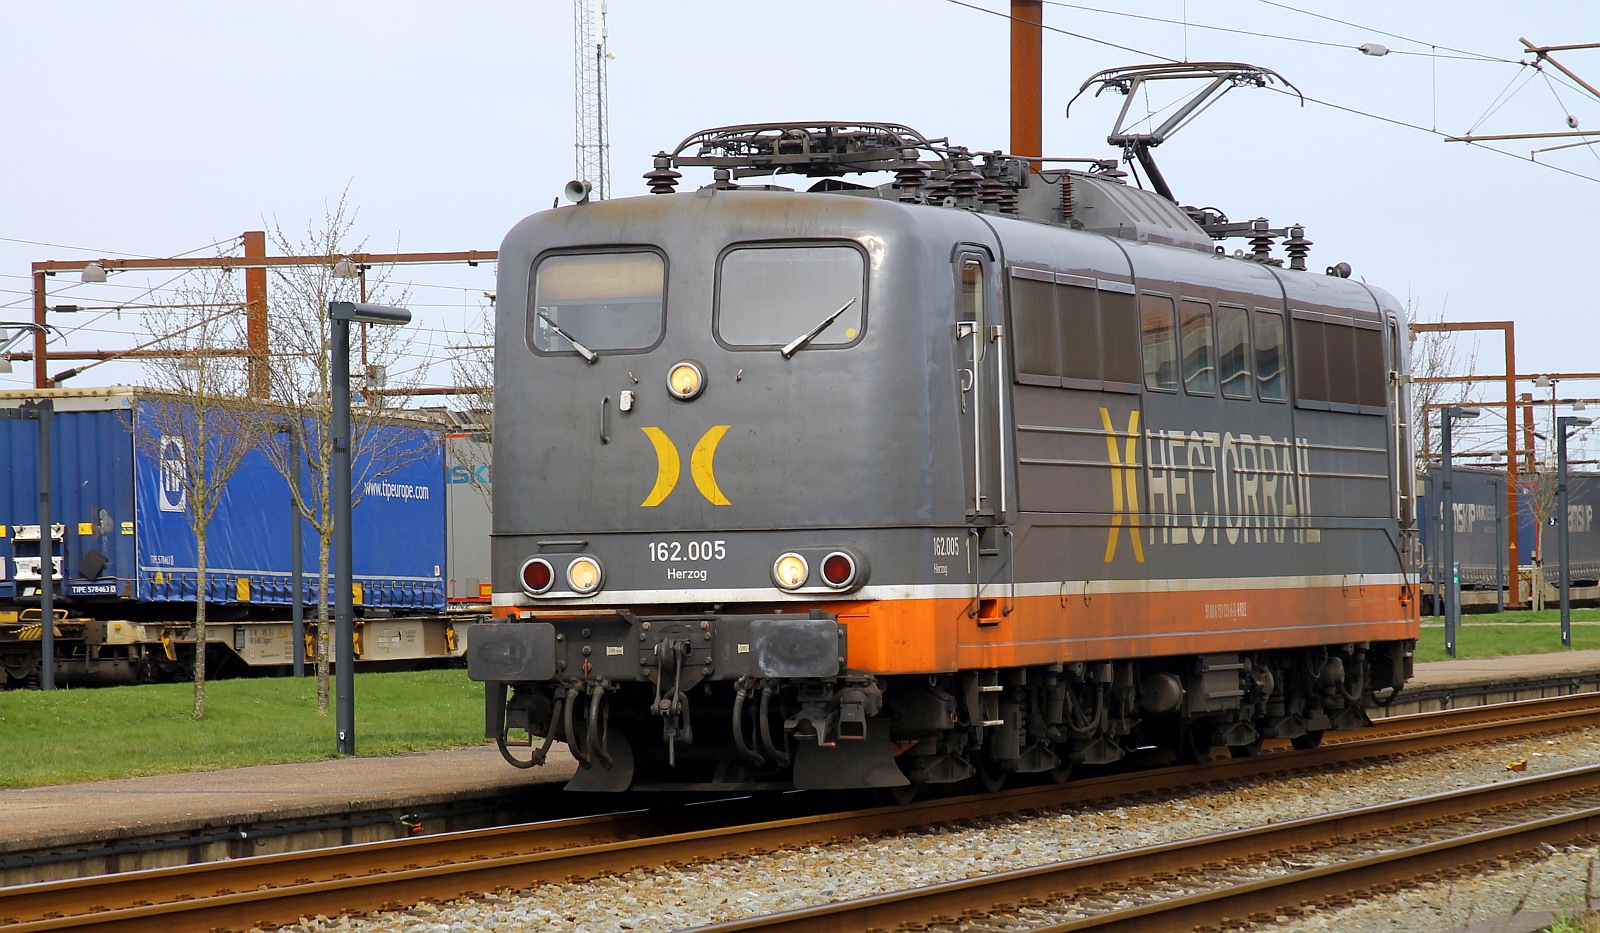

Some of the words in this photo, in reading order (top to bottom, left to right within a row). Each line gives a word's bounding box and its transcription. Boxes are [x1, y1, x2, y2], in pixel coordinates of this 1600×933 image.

[364, 479, 429, 502] www.tipeurope.com
[1146, 429, 1321, 545] HECTORRAIL
[648, 540, 726, 562] 162.005
[933, 536, 960, 556] 162.005
[965, 538, 971, 574] 1
[667, 568, 707, 581] Herzog
[933, 563, 948, 577] Herzog
[71, 586, 87, 594] TIPE
